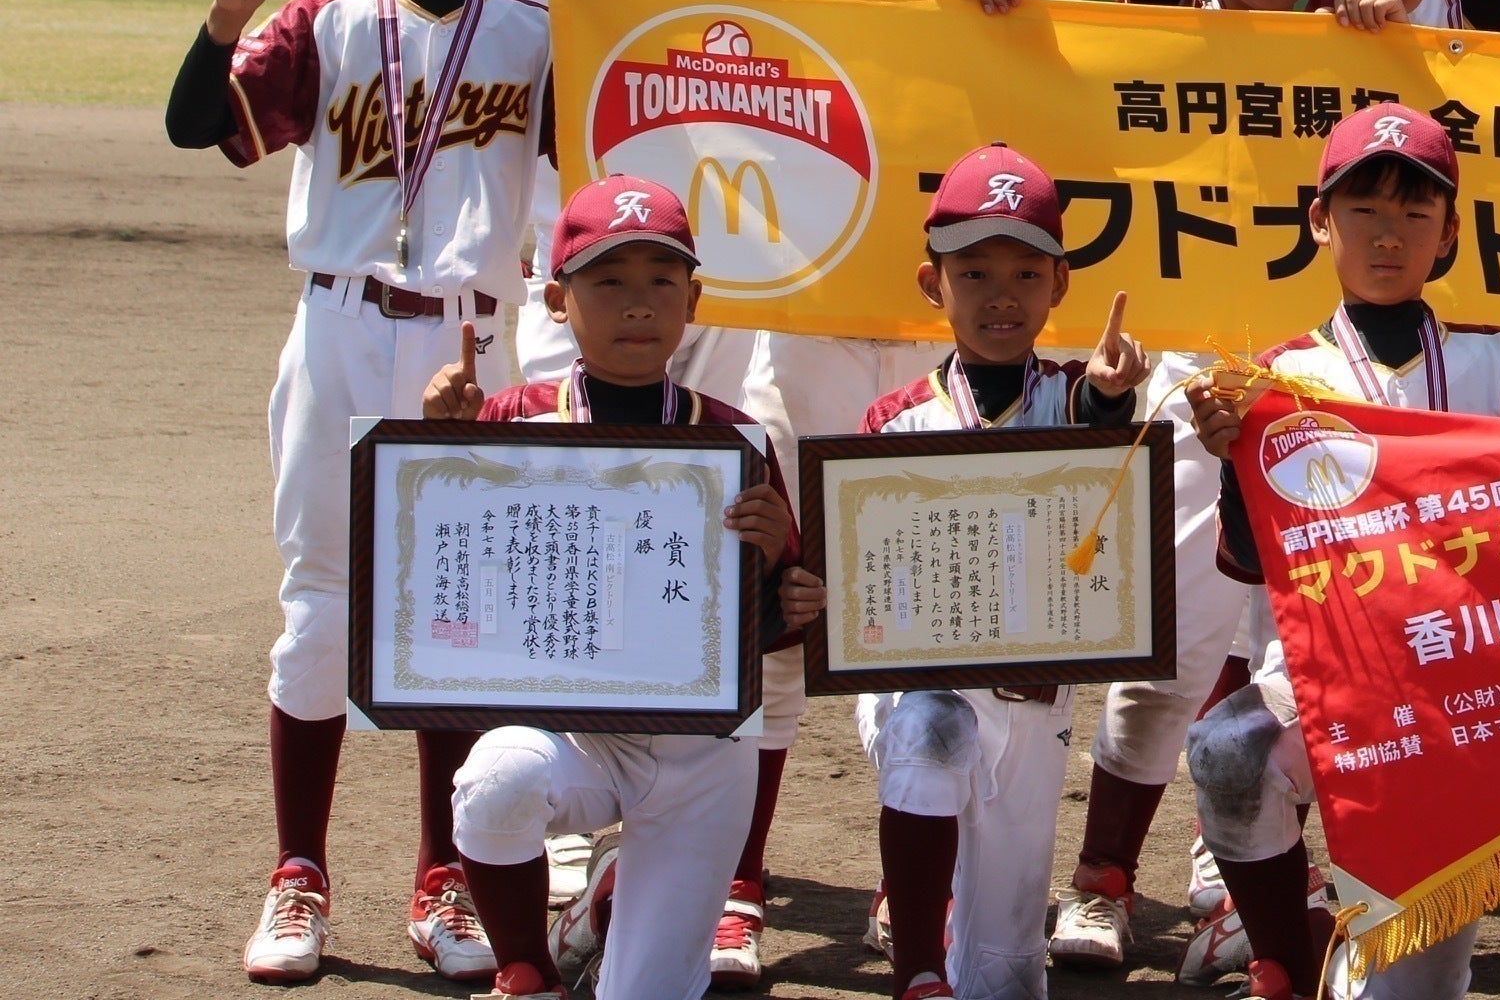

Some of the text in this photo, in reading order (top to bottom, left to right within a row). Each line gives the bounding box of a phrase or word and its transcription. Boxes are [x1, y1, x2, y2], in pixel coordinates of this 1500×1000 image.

[675, 54, 780, 79] McDonald's
[624, 71, 832, 144] TOURNAMENT
[481, 509, 497, 559] 令和七年
[634, 509, 655, 555] 優勝
[865, 550, 877, 573] 会長
[895, 528, 905, 562] 令和七年
[910, 511, 924, 616] ここに表彰します
[1280, 502, 1411, 556] 高円宮賜杯
[433, 522, 451, 624] 瀬戸内海放送
[453, 521, 471, 625] 朝日新聞高松総局
[662, 531, 690, 604] 賞状
[928, 510, 945, 644] 収められましたので
[947, 508, 964, 642] 発揮され頭書の成績を
[966, 510, 983, 643] の練習の成果を十分
[987, 507, 1001, 640] あなたのチームは日頃
[1334, 734, 1424, 774] 特別協賛
